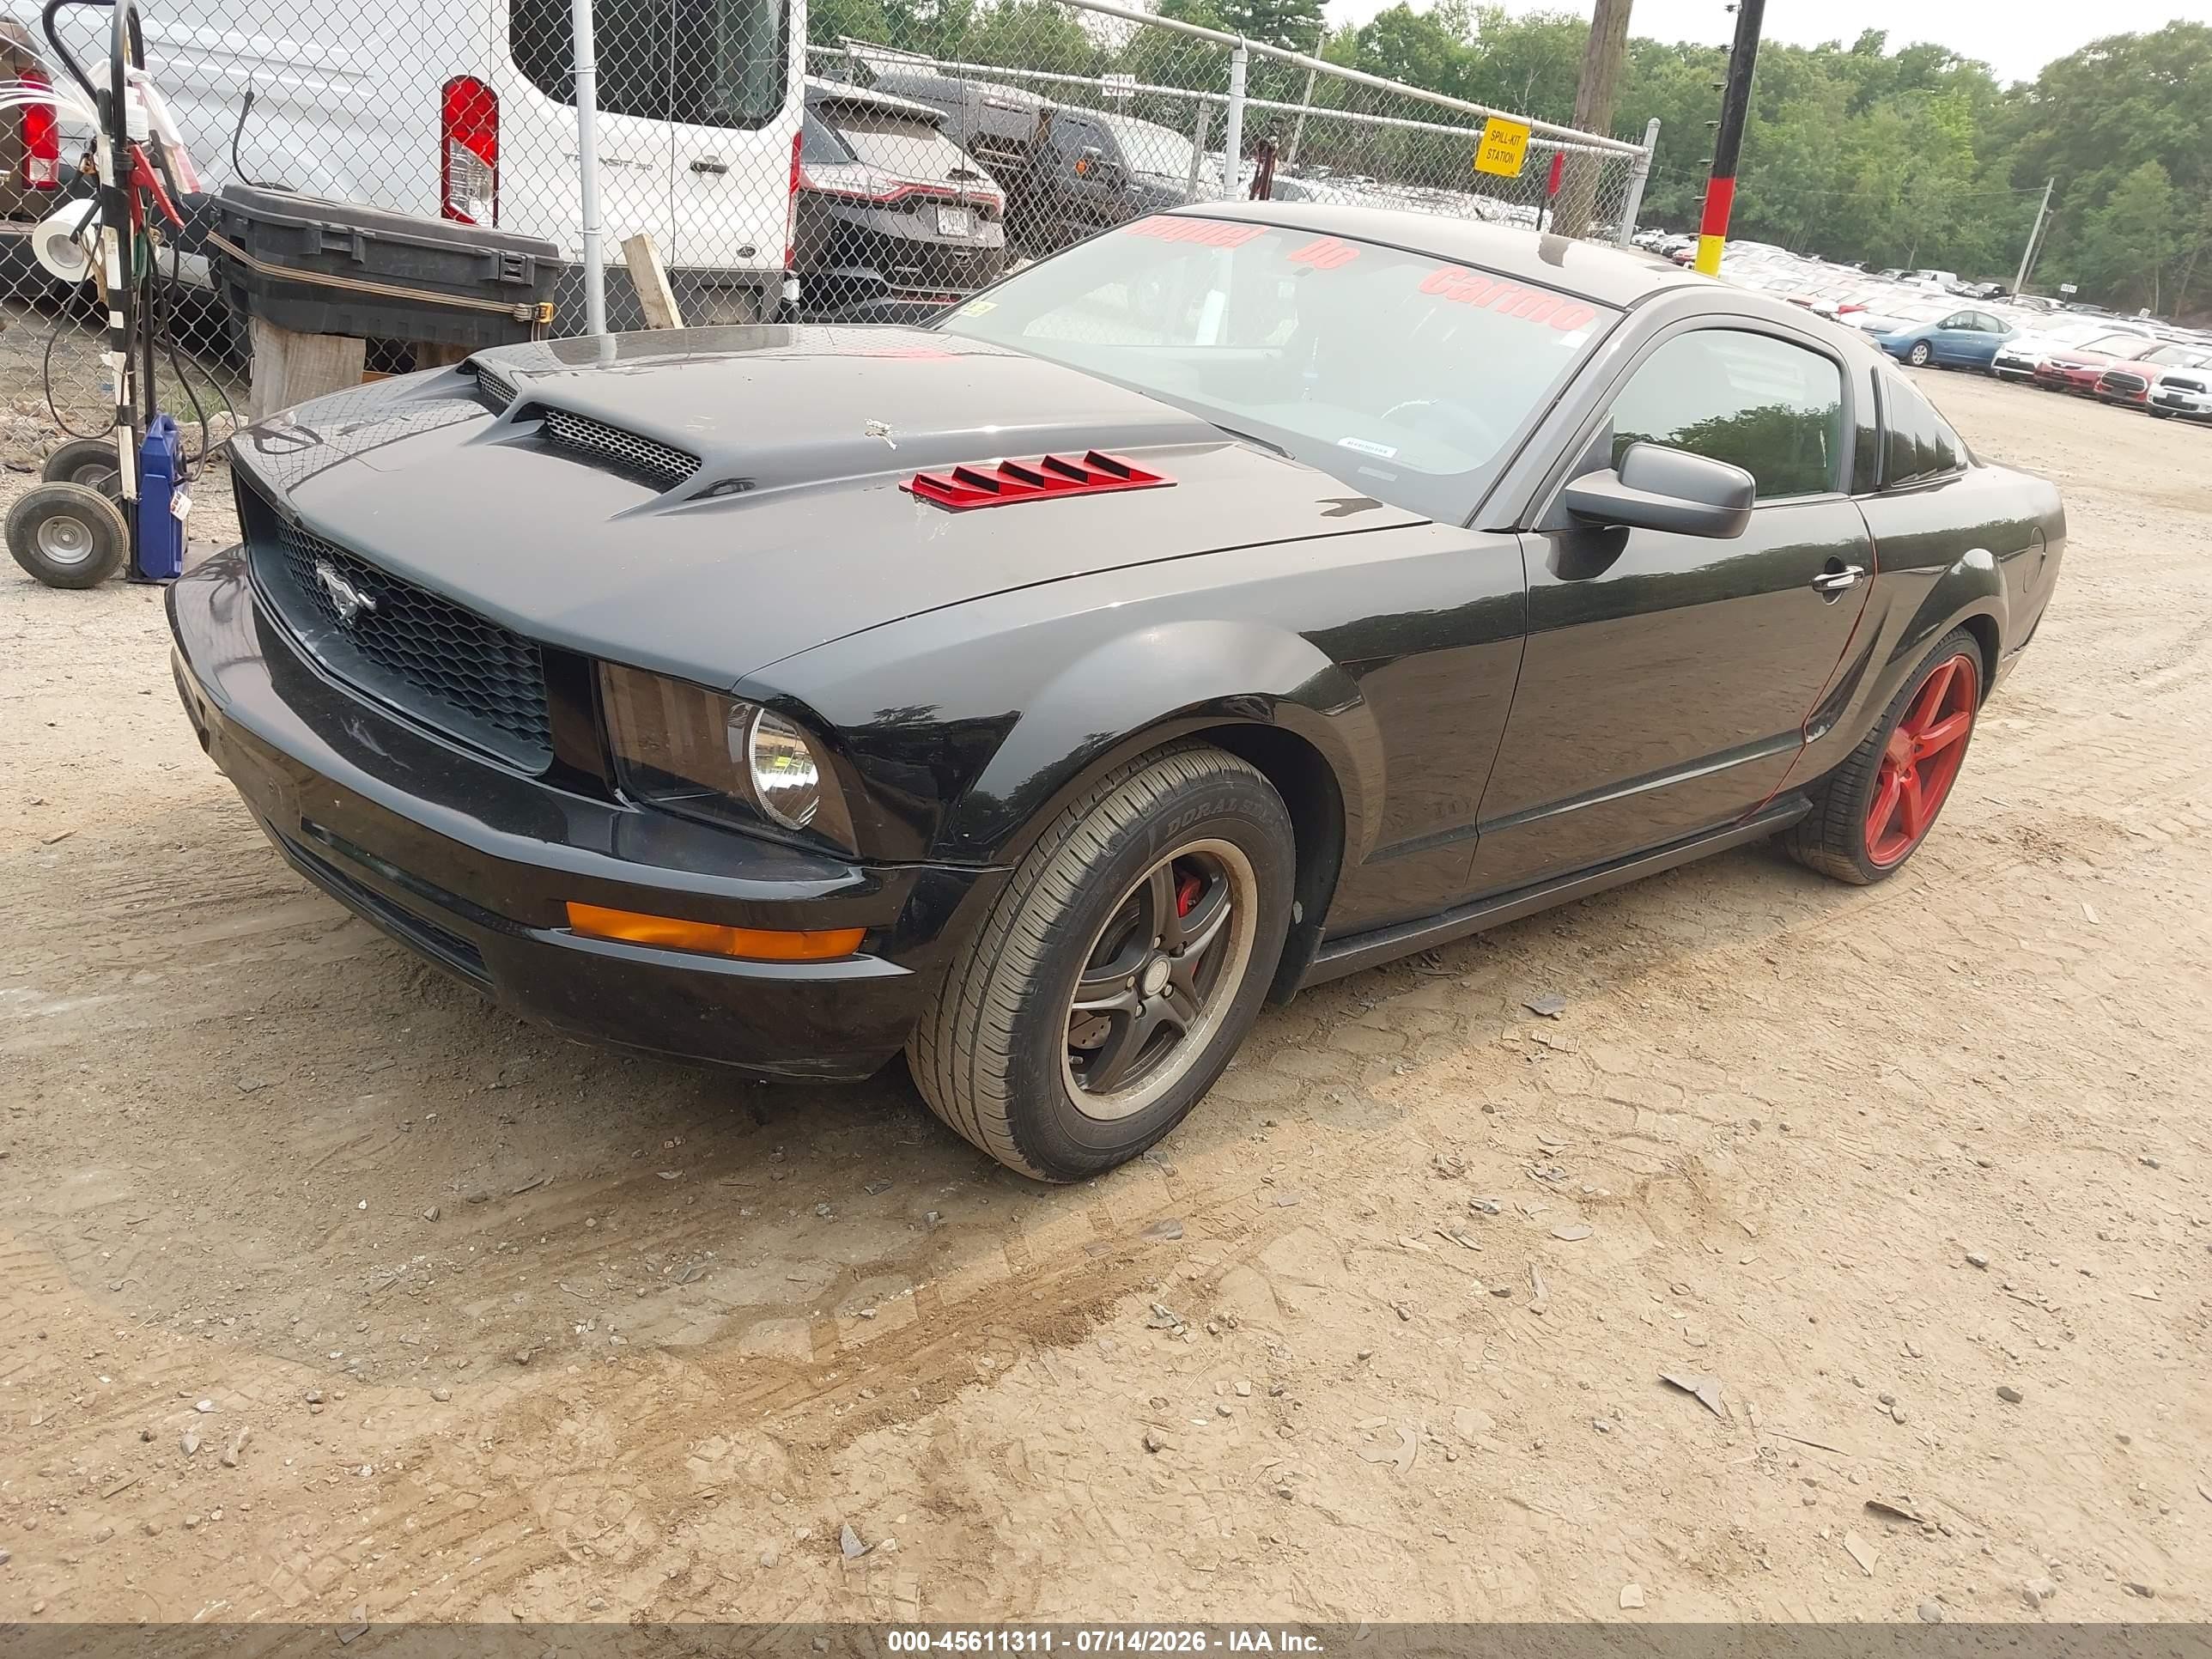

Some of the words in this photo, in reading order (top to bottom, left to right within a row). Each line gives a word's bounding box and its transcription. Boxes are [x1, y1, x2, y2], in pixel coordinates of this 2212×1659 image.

[1490, 130, 1522, 147] SPILL-KIT
[563, 153, 634, 168] TRNSIT
[1486, 148, 1516, 164] STATION
[1418, 265, 1596, 331] Carmo
[1165, 798, 1237, 840] DORAL
